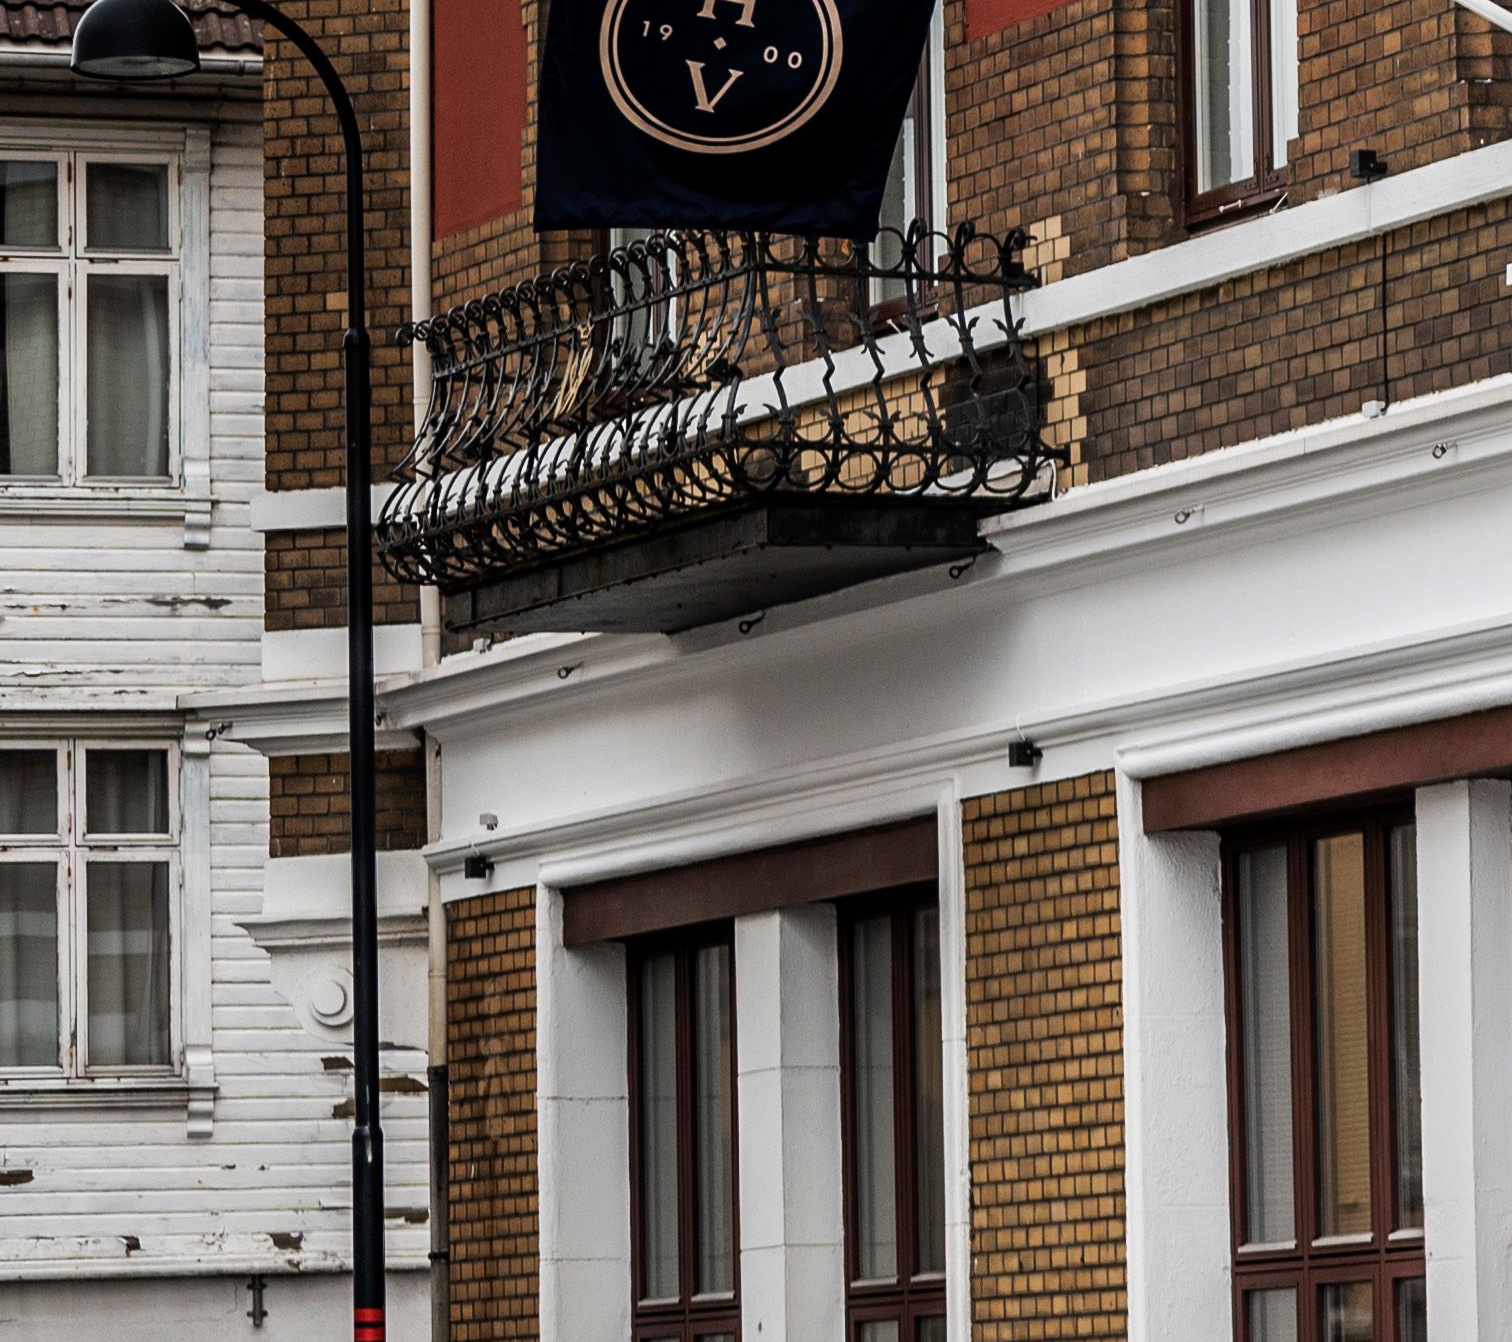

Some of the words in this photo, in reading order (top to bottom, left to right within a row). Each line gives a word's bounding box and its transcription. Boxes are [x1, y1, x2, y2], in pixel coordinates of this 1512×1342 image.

[642, 20, 673, 41] 19
[763, 46, 802, 69] 00
[685, 59, 744, 113] V
